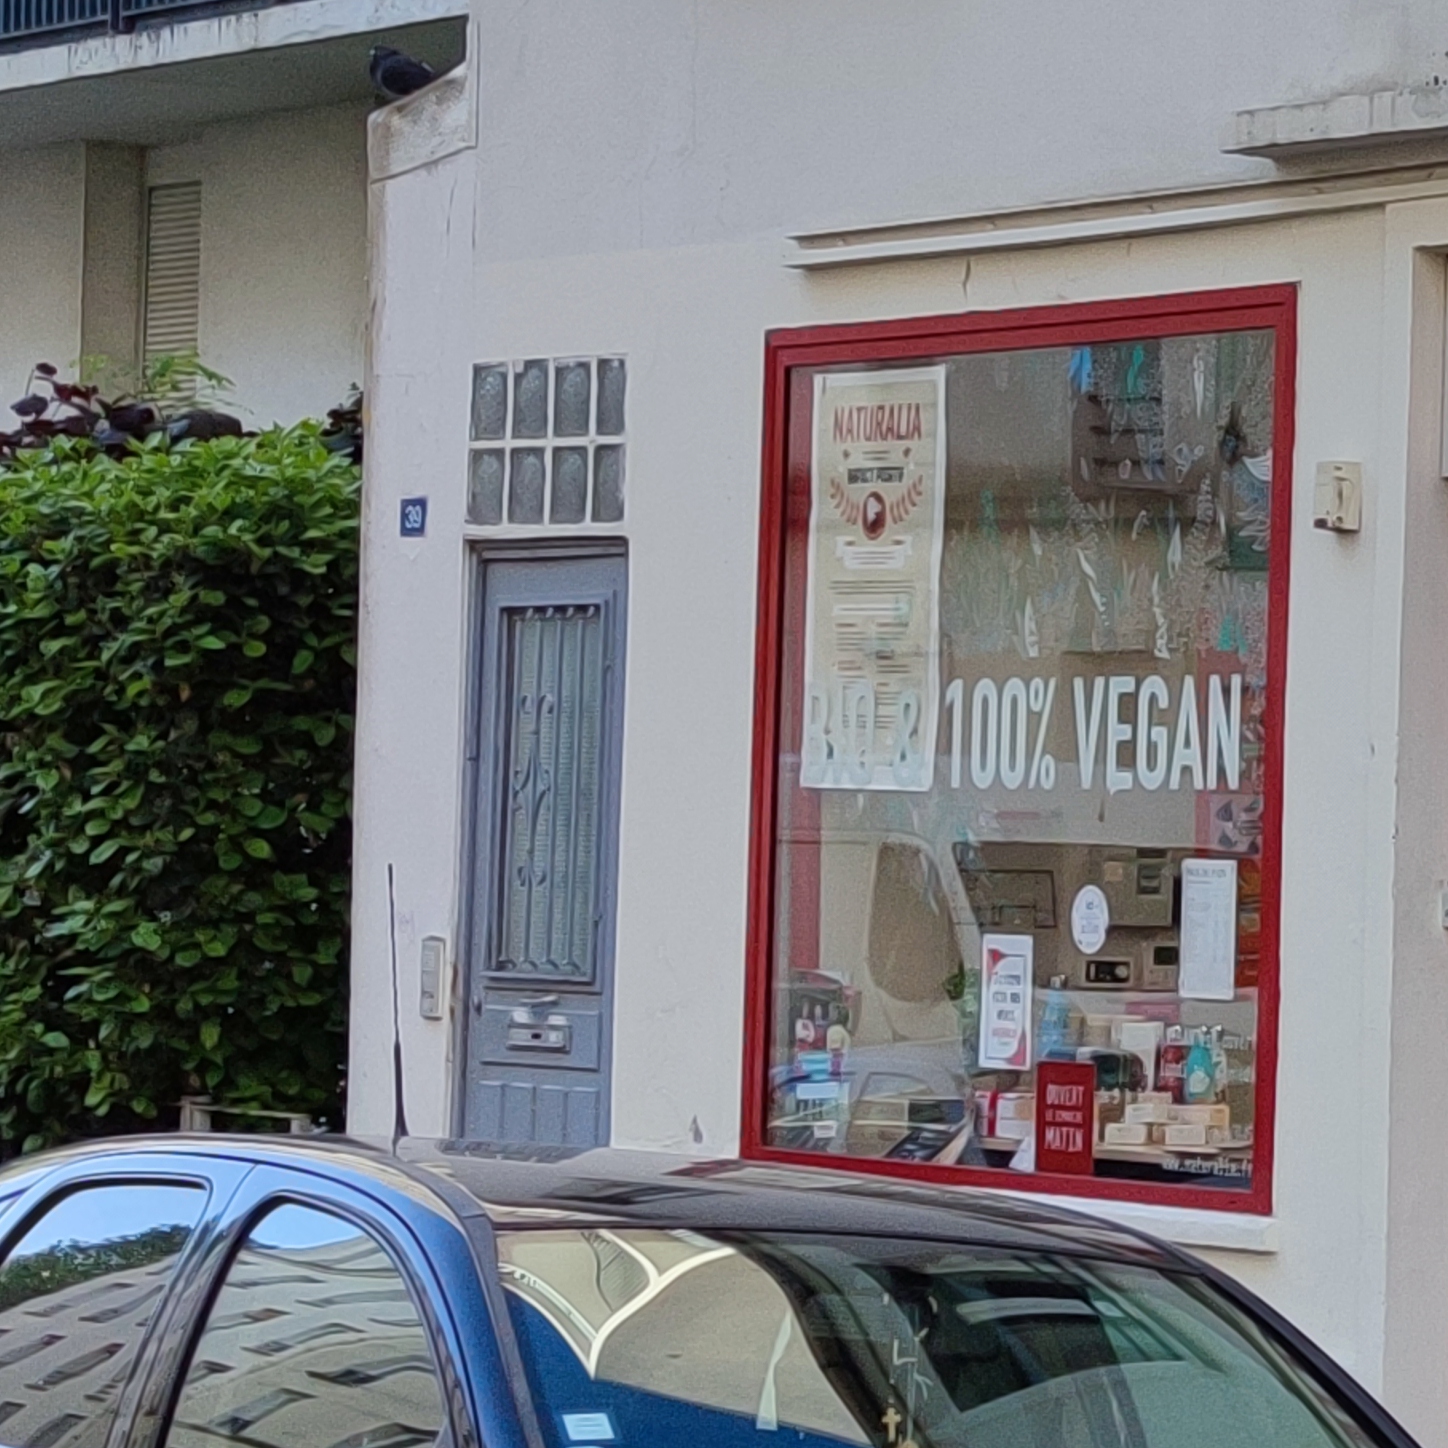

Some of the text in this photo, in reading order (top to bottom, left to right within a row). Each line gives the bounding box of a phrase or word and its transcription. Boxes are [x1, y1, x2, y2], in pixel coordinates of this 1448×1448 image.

[833, 403, 923, 444] NATURALIA
[944, 676, 1058, 791] 100%
[1072, 673, 1242, 793] VEGAN
